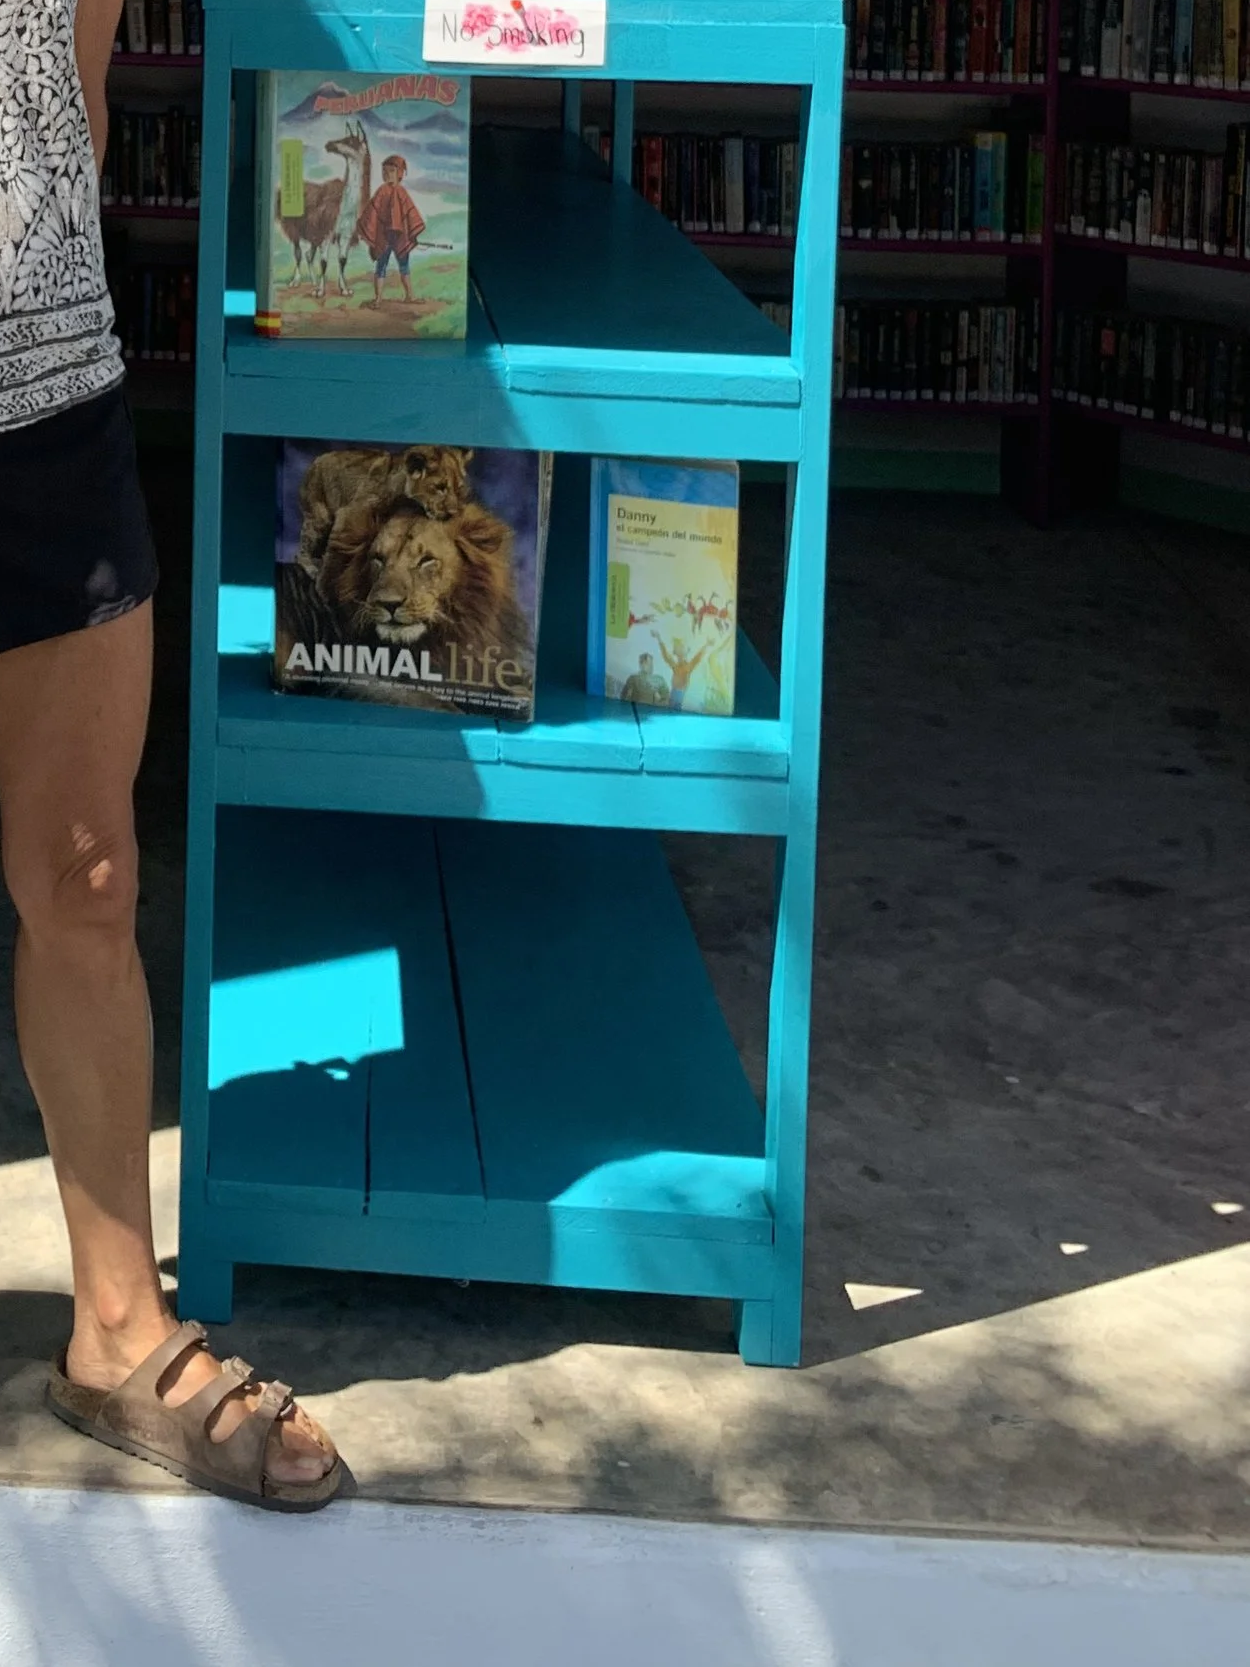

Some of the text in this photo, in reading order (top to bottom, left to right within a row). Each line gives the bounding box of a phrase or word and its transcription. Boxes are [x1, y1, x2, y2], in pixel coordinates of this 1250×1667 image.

[442, 13, 586, 59] No Smoking
[313, 74, 460, 116] PERUANAS
[616, 507, 657, 526] Danny
[673, 530, 687, 541] del
[689, 533, 723, 545] mundo
[285, 641, 443, 682] ANIMAL
[445, 640, 525, 695] life
